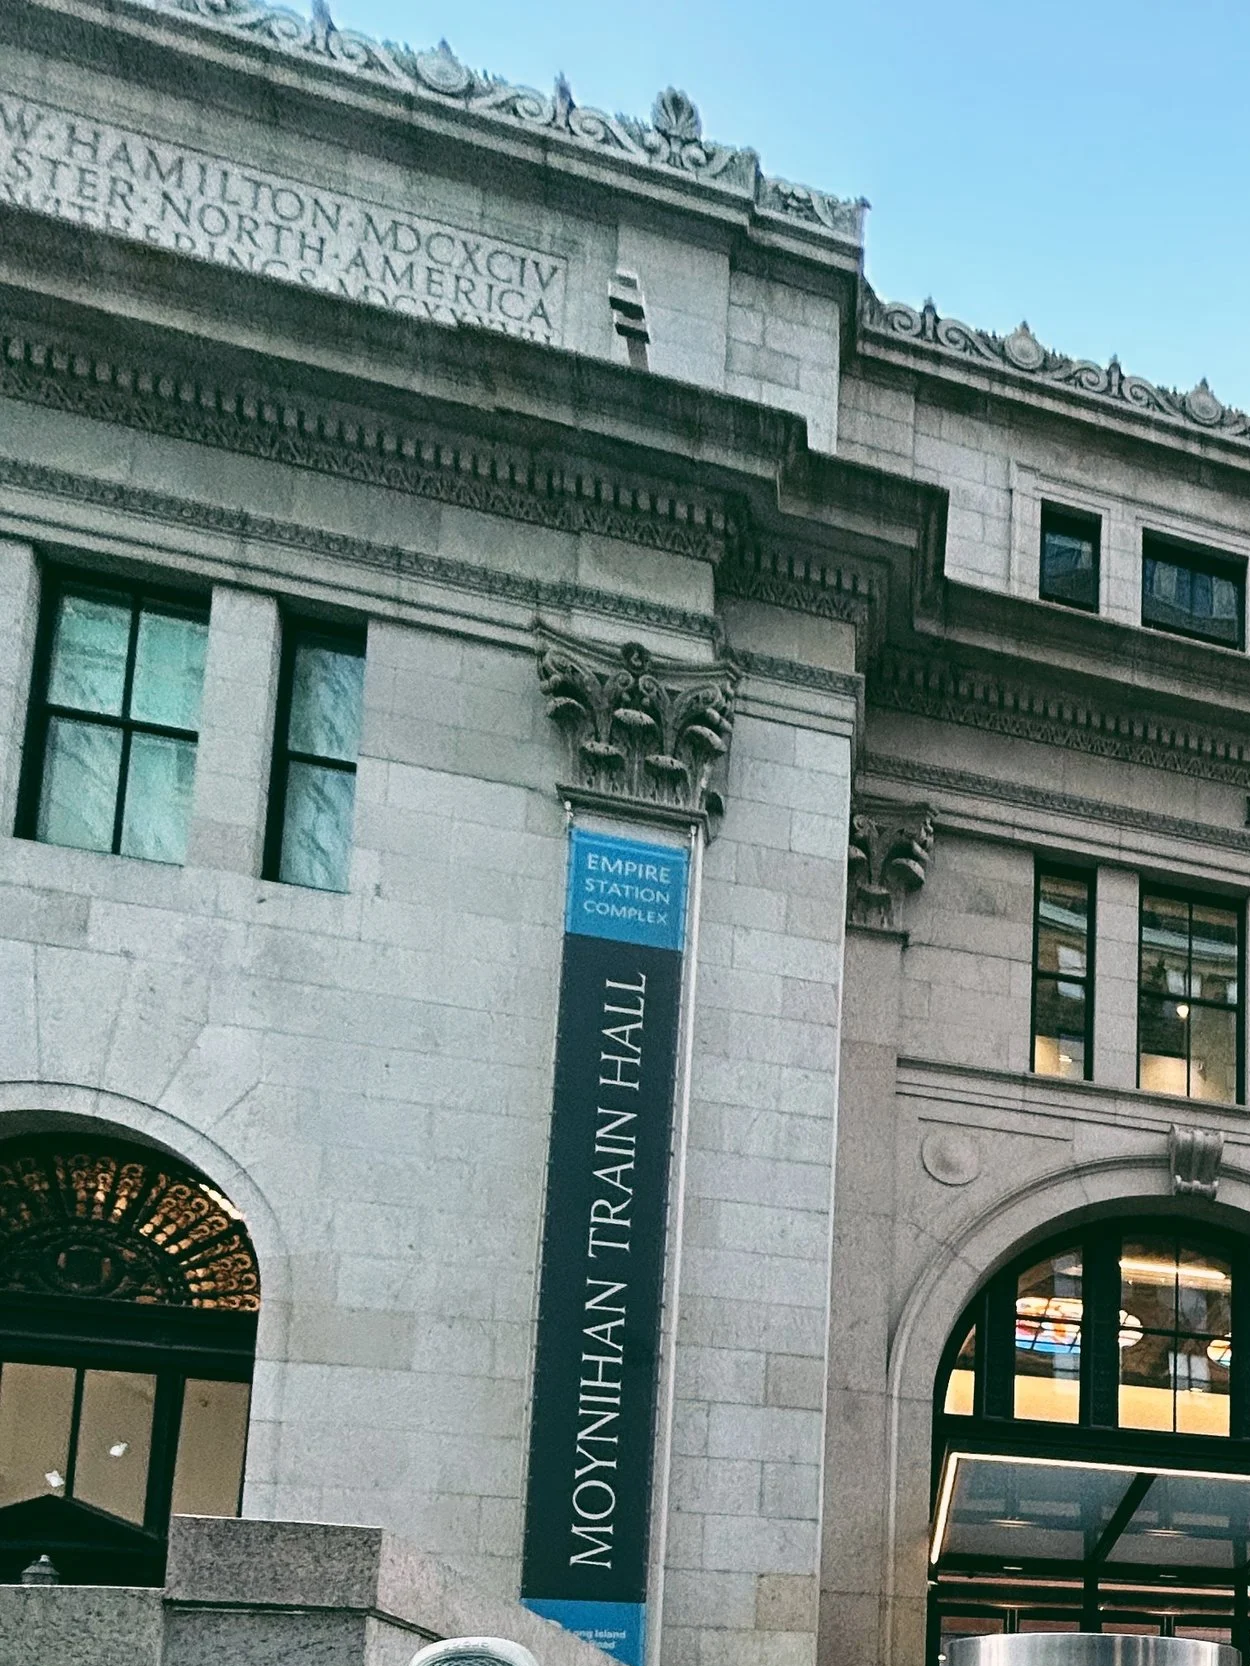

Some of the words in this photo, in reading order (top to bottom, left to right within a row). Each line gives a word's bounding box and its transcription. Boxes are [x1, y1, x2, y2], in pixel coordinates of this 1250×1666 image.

[66, 122, 341, 235] HAMILTON
[161, 190, 326, 266] NORTH
[343, 246, 555, 330] AMERICA
[583, 900, 668, 925] COMPLEX
[585, 878, 670, 905] STATION
[587, 853, 671, 884] EMPIRE
[598, 971, 648, 1091] HALL
[588, 1106, 638, 1258] TRAIN
[569, 1278, 627, 1570] MOYNIHAN
[568, 1629, 592, 1639] ong
[594, 1629, 627, 1639] Island
